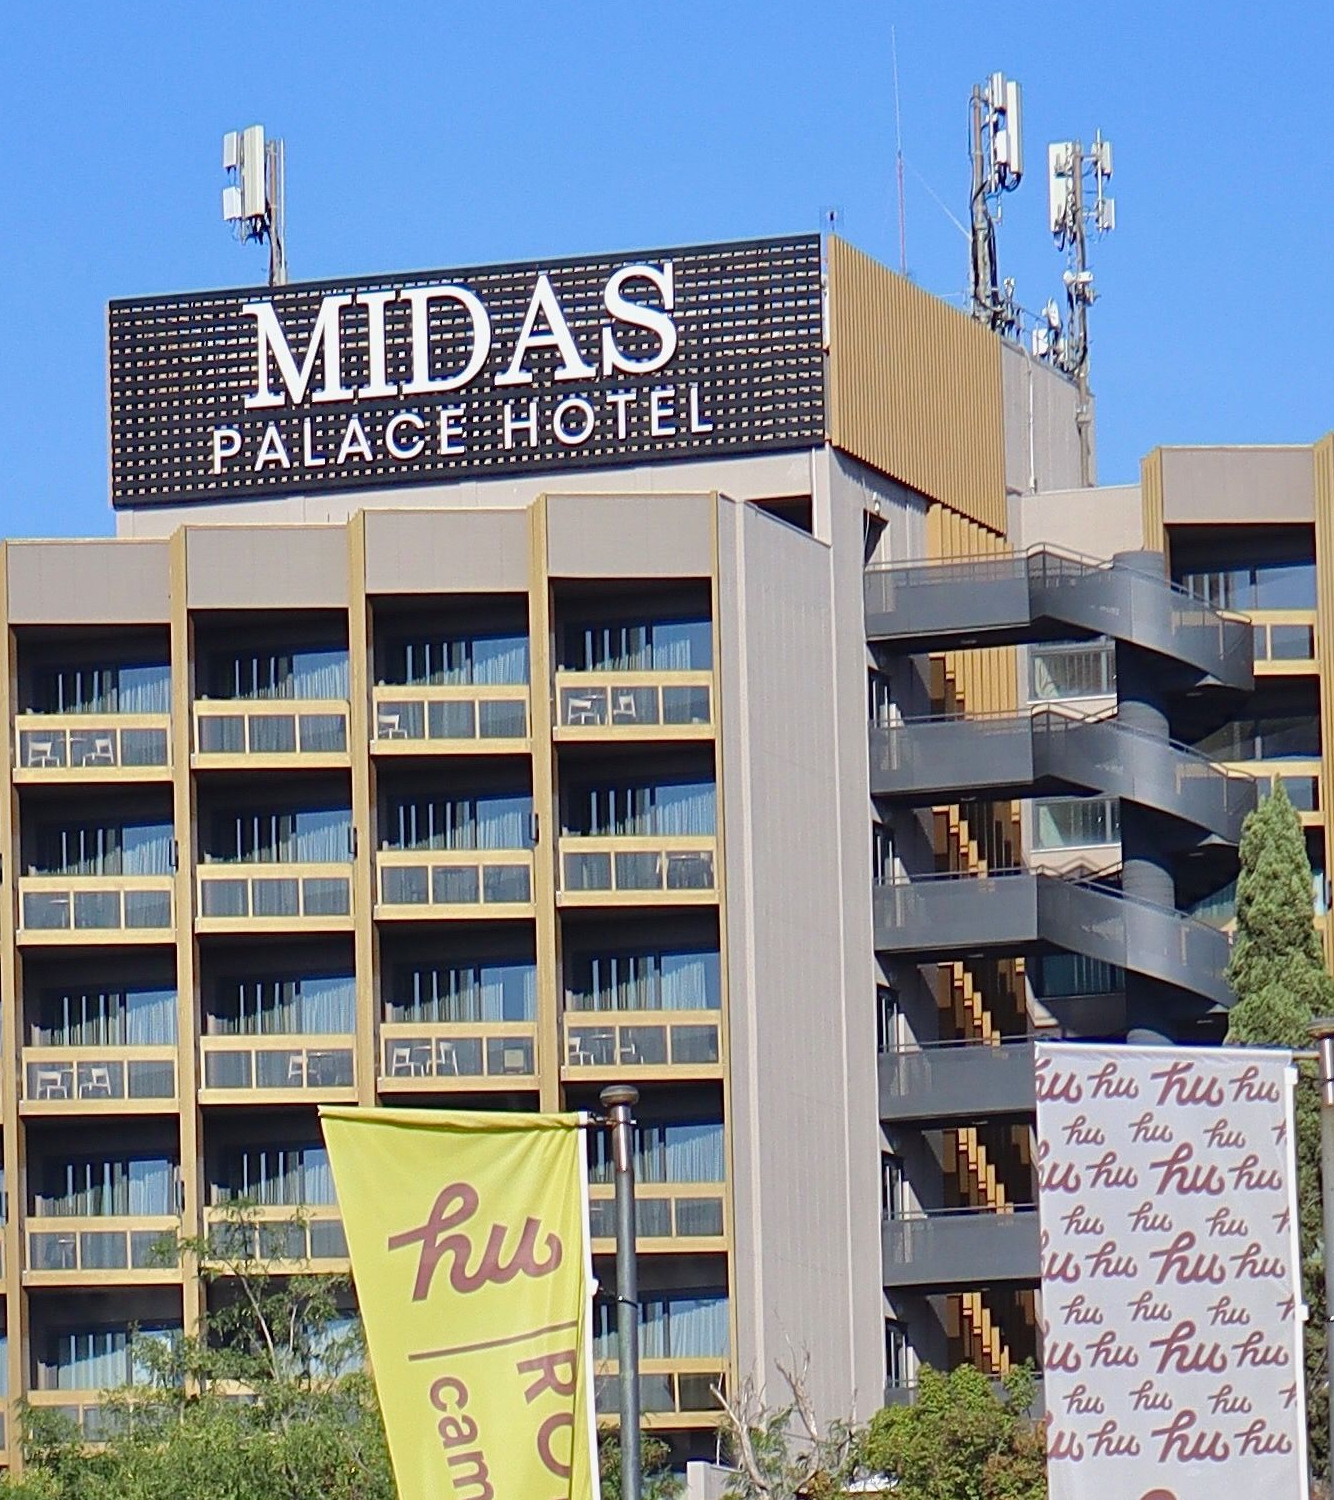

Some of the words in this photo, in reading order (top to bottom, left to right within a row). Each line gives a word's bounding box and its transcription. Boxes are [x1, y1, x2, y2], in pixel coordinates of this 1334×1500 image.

[241, 261, 678, 411] MIDAS
[212, 405, 466, 475] PALACE
[503, 382, 714, 451] HOTEL
[388, 1181, 564, 1303] hu
